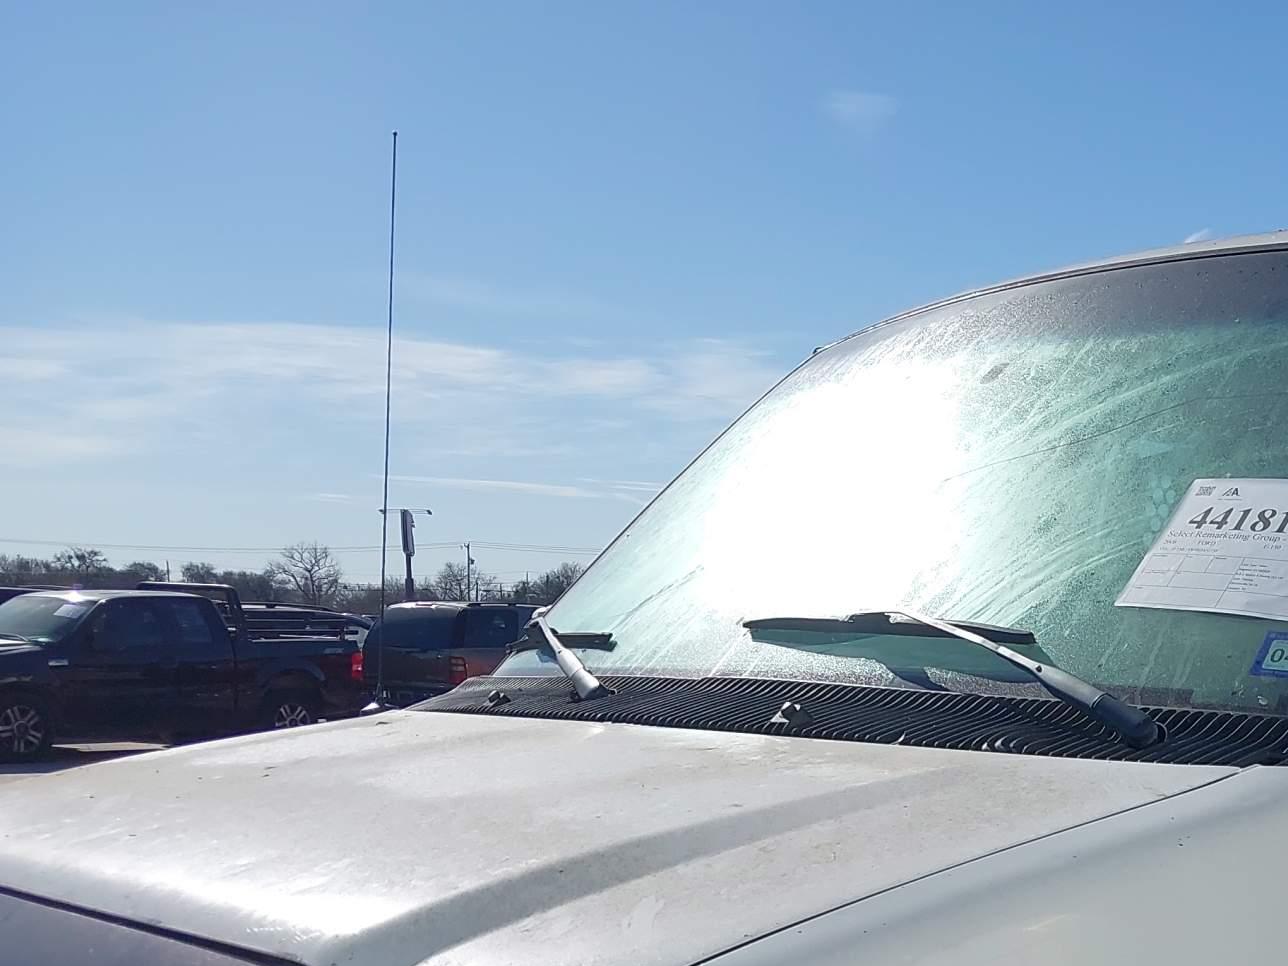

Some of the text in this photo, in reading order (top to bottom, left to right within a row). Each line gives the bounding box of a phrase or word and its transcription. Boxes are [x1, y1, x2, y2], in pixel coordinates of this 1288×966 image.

[1167, 530, 1194, 538] Select
[1194, 531, 1251, 542] Remarketing
[1252, 533, 1281, 543] Group
